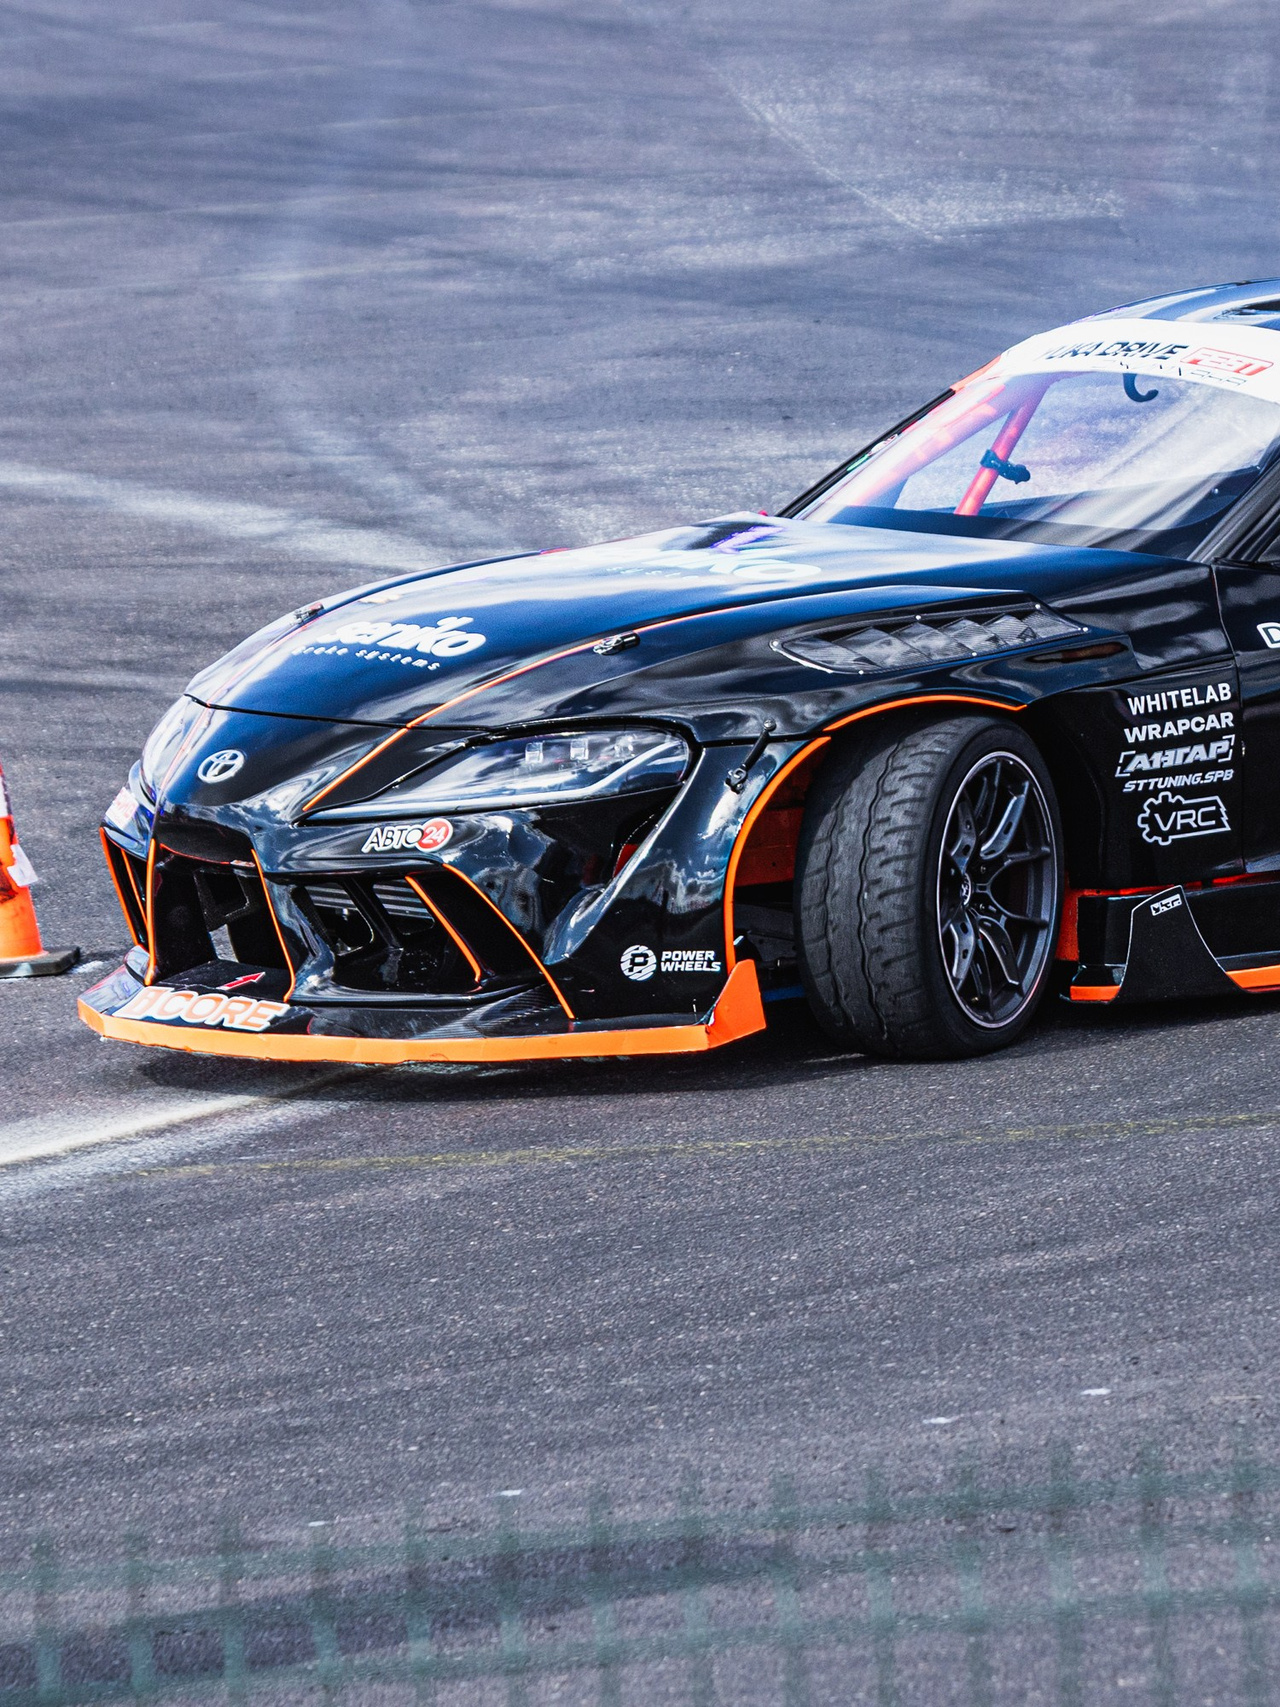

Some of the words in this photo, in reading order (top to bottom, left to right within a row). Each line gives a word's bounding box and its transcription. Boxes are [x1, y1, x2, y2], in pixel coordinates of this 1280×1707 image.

[1095, 340, 1190, 361] DRIVE
[1127, 682, 1232, 716] WHITELAB
[1123, 711, 1235, 744] WRAPCAR
[1122, 768, 1234, 793] STTUNING.SPB
[1153, 805, 1217, 832] VRC
[660, 961, 722, 972] WHEELS
[661, 950, 716, 961] POWER
